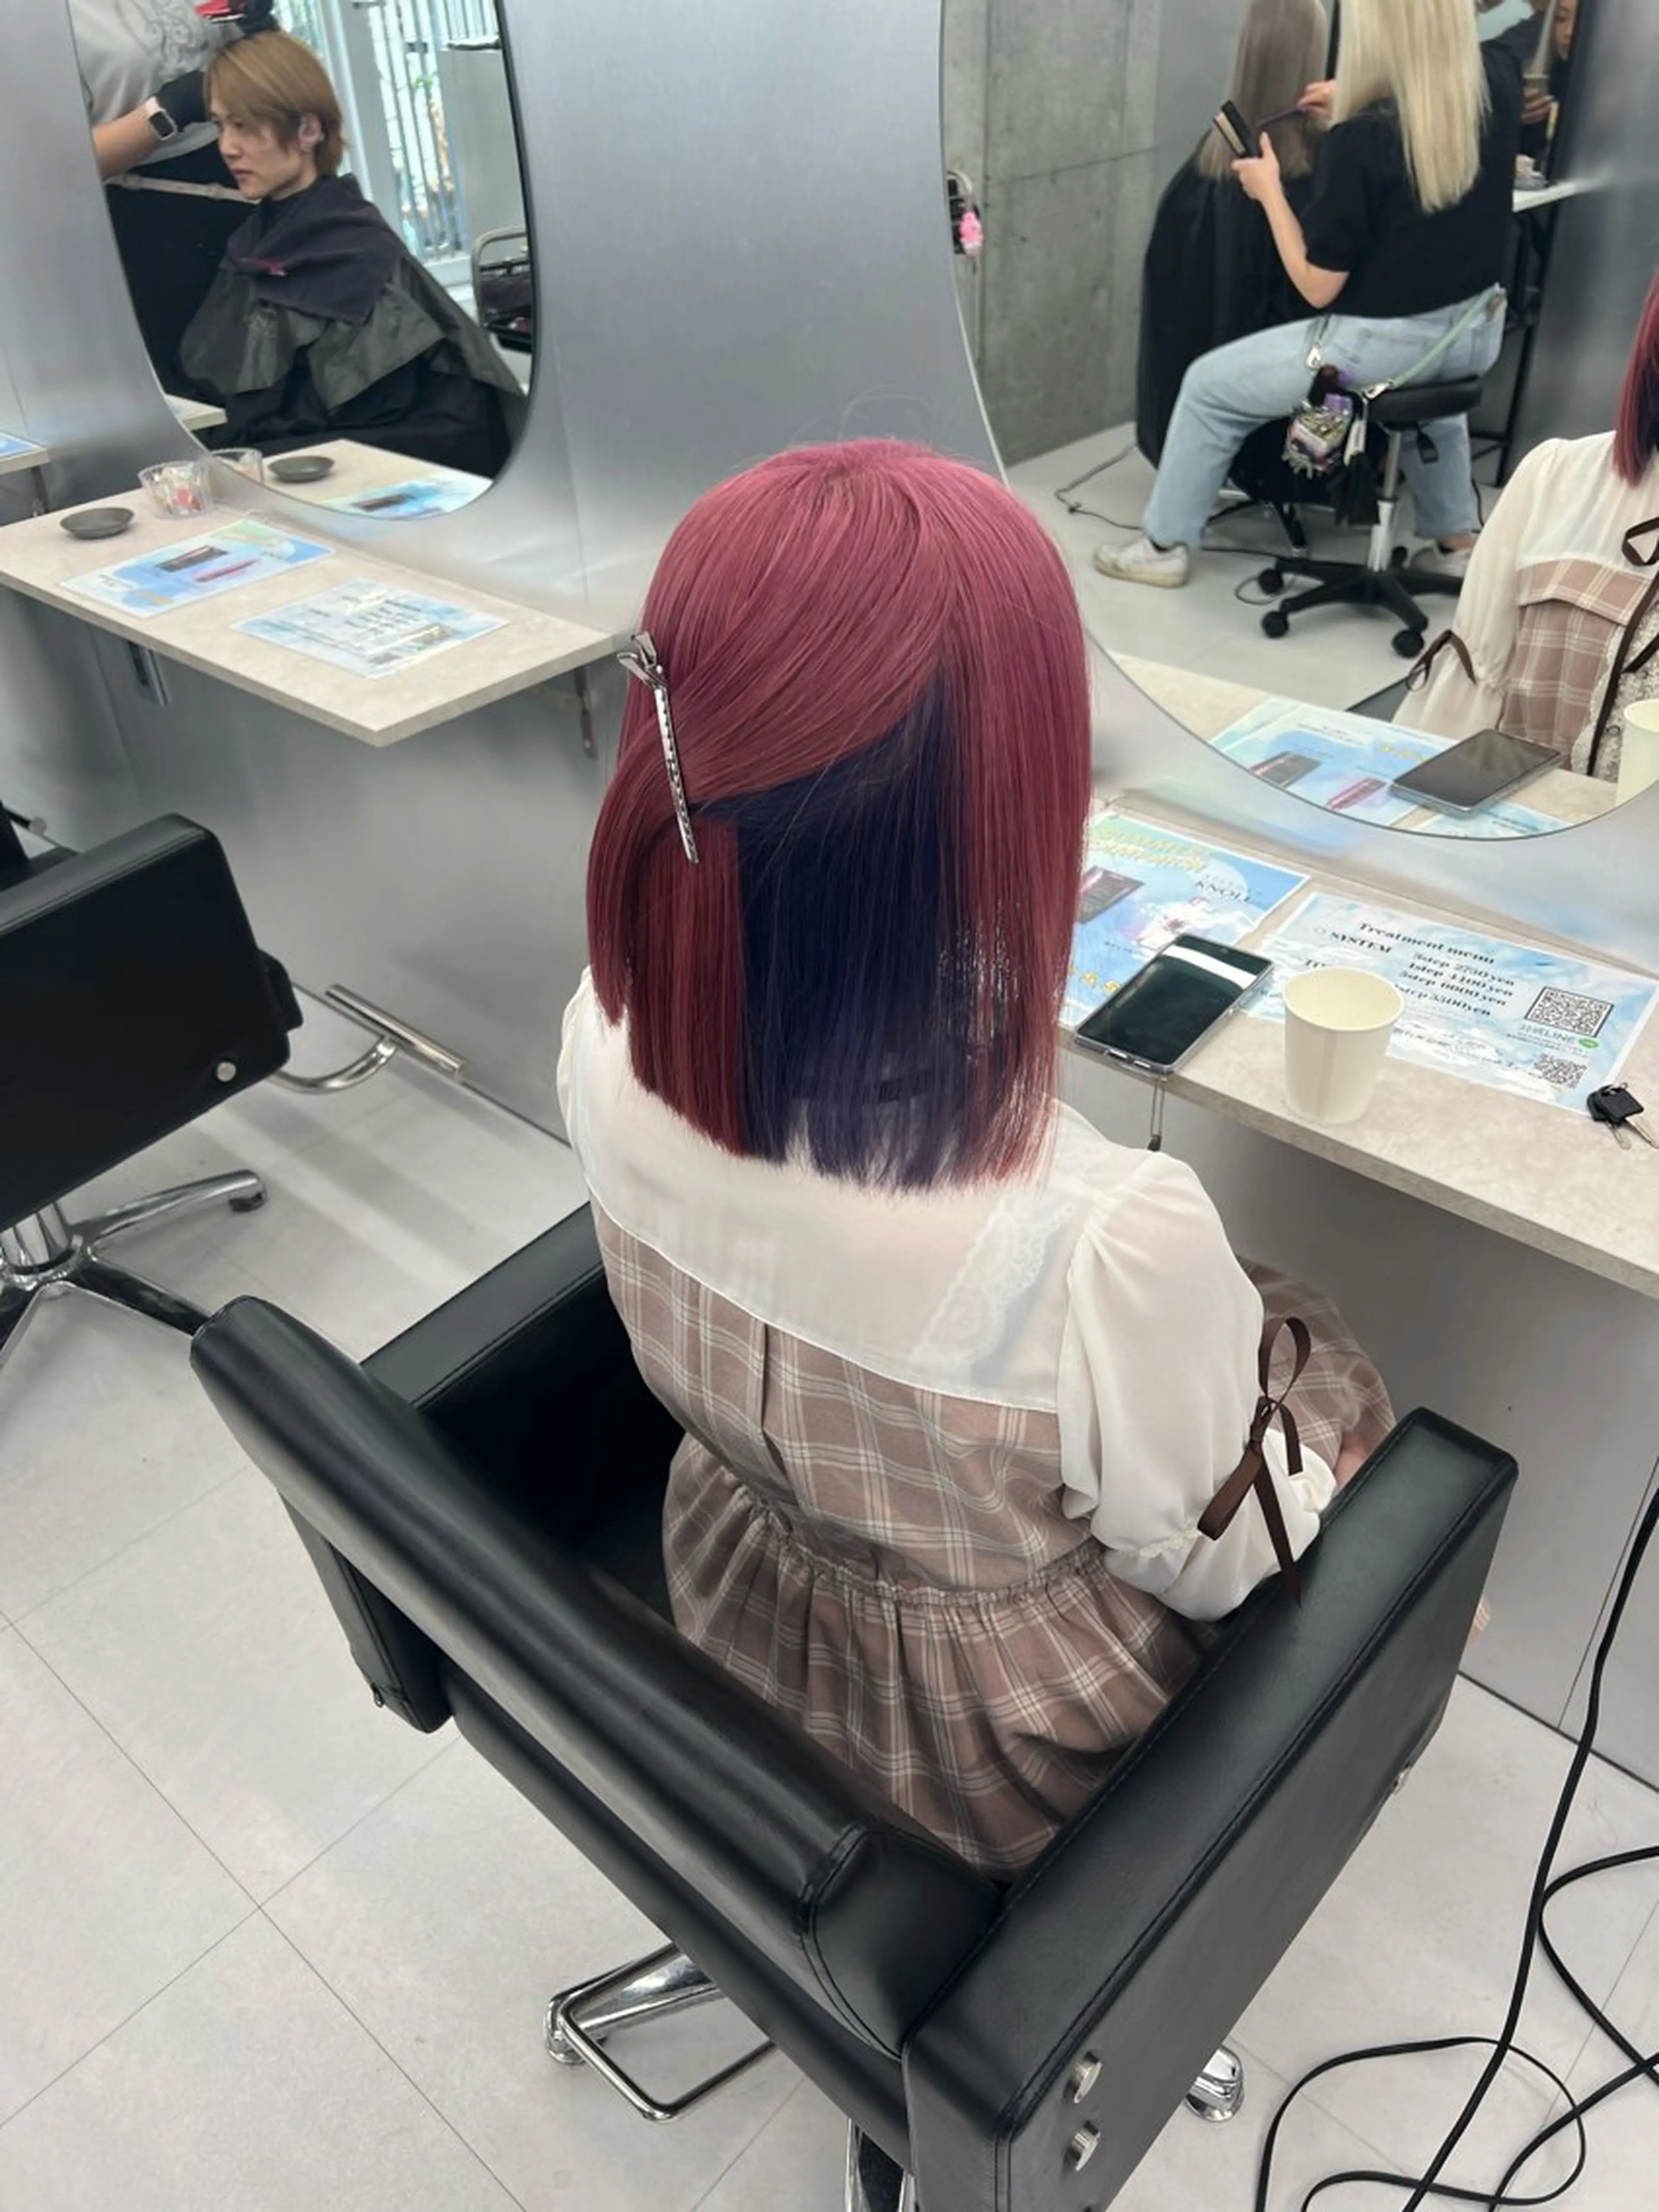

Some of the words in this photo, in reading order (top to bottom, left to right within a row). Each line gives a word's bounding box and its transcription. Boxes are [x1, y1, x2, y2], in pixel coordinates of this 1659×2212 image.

[1329, 931, 1392, 953] SYSTEM
[1360, 922, 1445, 950] Treatment
[1447, 947, 1495, 964] menu
